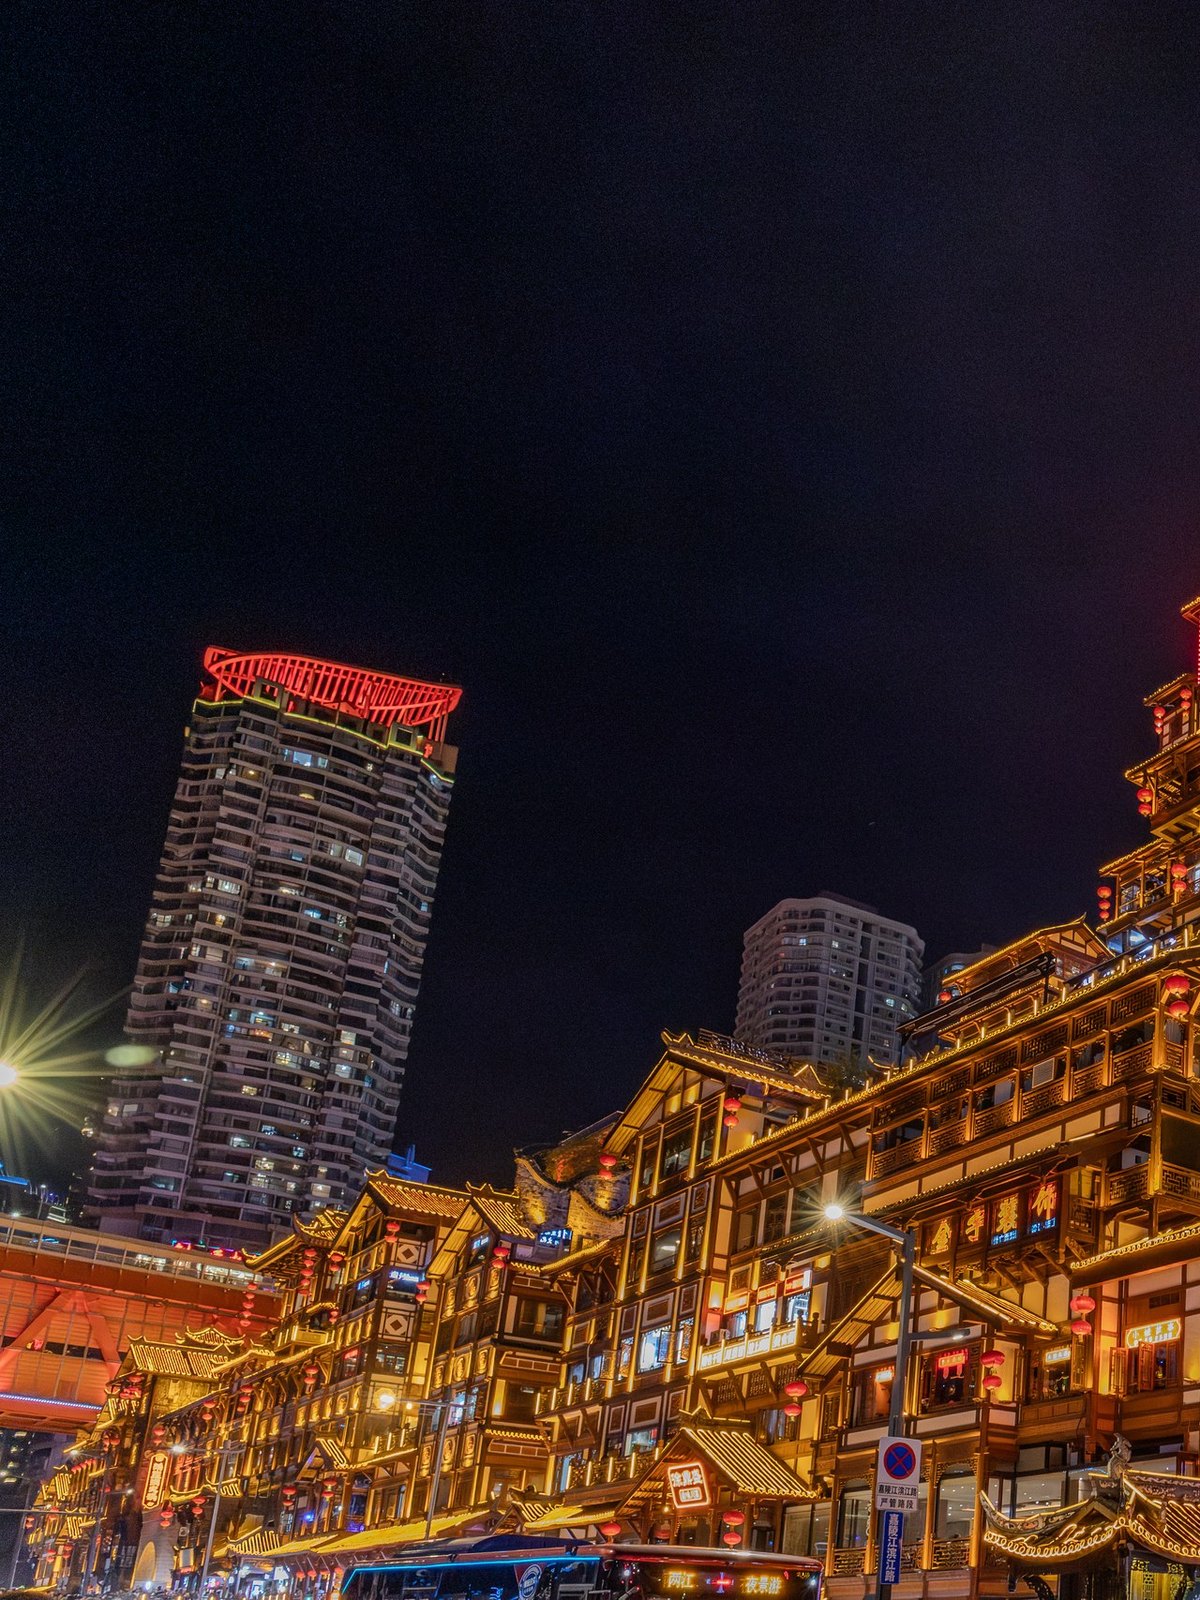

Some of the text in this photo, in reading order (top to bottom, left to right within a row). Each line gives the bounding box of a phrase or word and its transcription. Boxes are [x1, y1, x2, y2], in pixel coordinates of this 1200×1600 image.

[878, 1484, 917, 1497] 嘉陵江滨江路
[880, 1497, 914, 1509] 严管路段
[885, 1513, 900, 1582] 嘉陵江滨江路
[667, 1570, 782, 1594] 两江 夜景游
